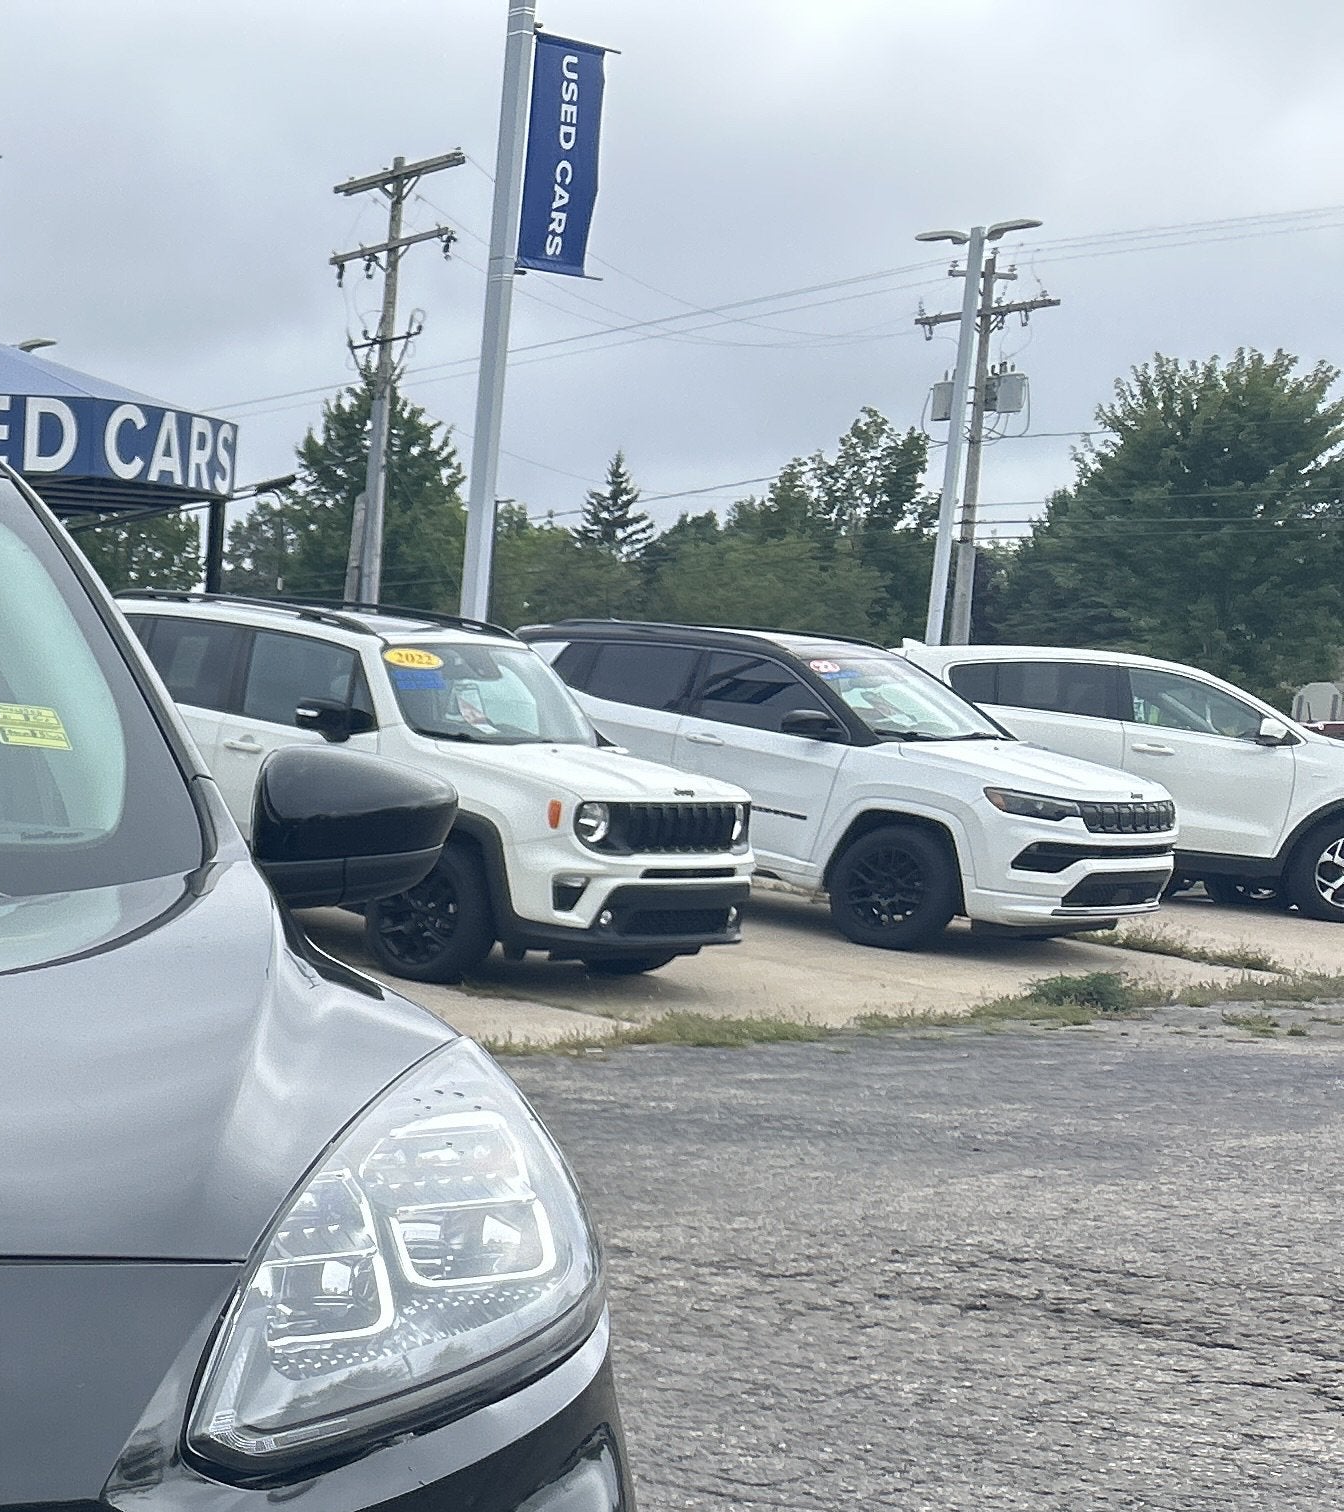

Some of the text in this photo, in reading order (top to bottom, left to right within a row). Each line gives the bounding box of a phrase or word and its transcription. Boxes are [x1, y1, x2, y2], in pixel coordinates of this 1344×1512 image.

[544, 54, 579, 257] USED CARS
[104, 403, 235, 495] CARS
[393, 651, 436, 666] 2022
